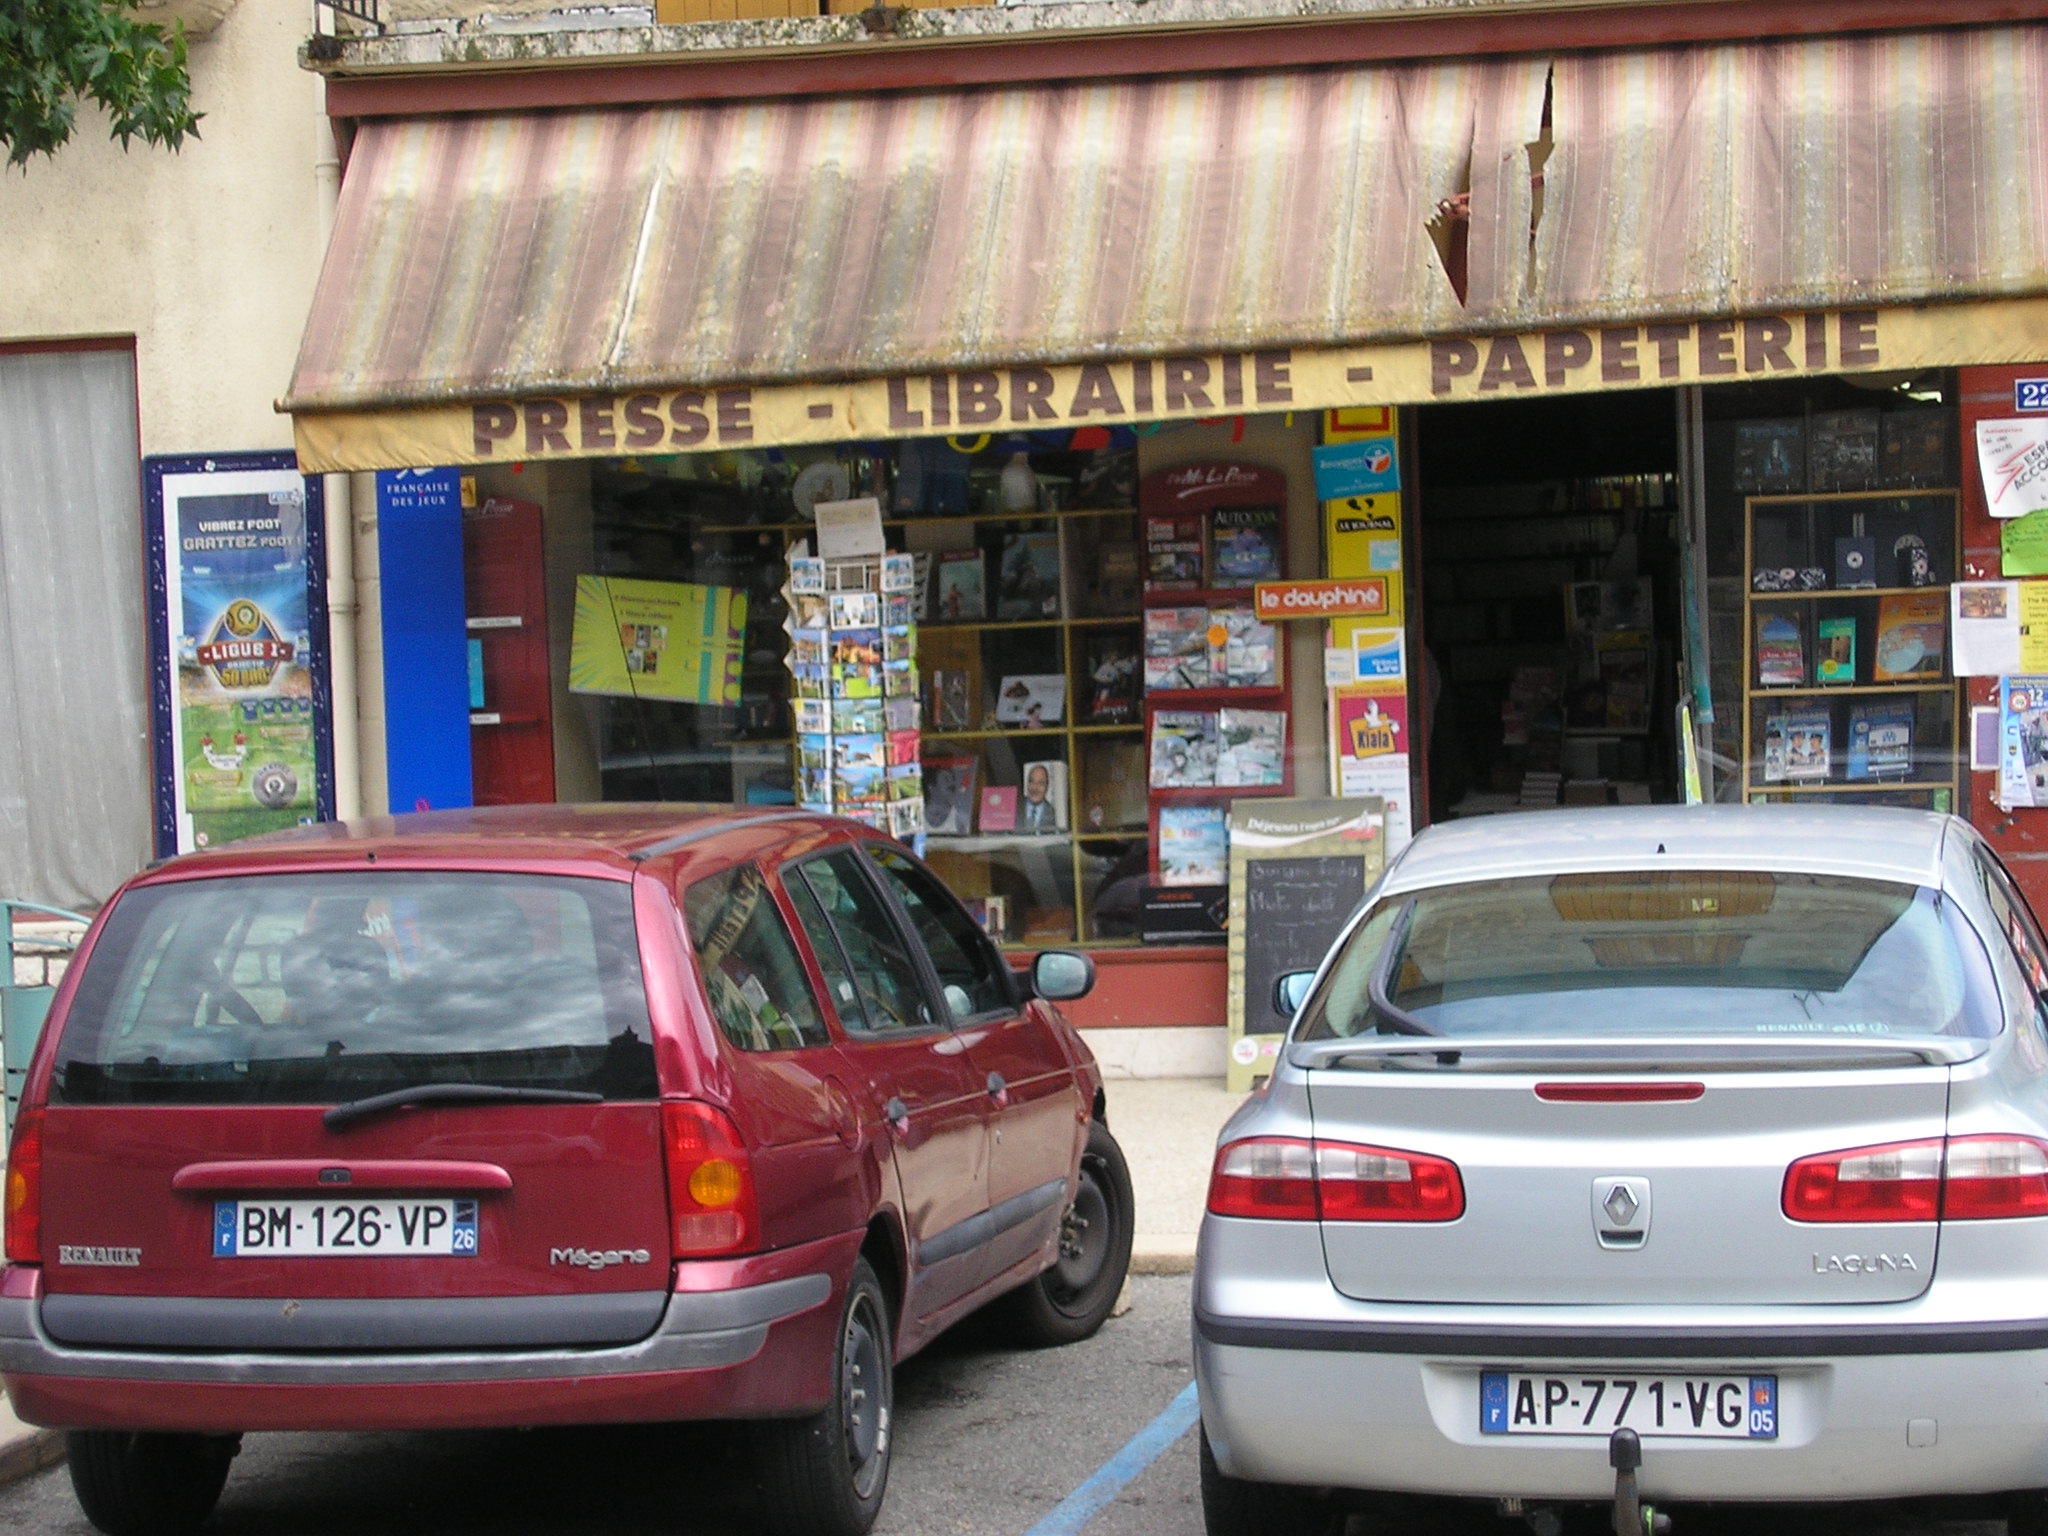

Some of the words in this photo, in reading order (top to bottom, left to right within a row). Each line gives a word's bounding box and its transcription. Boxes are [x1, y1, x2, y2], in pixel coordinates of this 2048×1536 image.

[473, 388, 754, 457] PRESSE
[887, 350, 1294, 430] LIBRAIRIE
[1430, 310, 1880, 396] PAPETERIE
[2023, 440, 2048, 466] ESP
[2014, 456, 2048, 491] ACCO
[386, 482, 450, 495] FRANÇAISE
[391, 497, 413, 507] DES
[418, 495, 446, 507] JEUX
[198, 519, 245, 532] VIBREZ
[247, 518, 282, 530] FOOT
[183, 536, 257, 551] GRATTEZ
[260, 536, 293, 547] FOOT
[1260, 589, 1280, 608] le
[211, 641, 264, 660] LIGUE
[1357, 729, 1390, 749] Kiala
[1755, 1022, 1824, 1033] RENAULT
[242, 1204, 447, 1248] BM-126-VP
[222, 1233, 231, 1247] F
[454, 1229, 475, 1250] 26
[59, 1245, 142, 1267] RENAULT
[549, 1247, 651, 1270] Mégane
[1812, 1252, 1918, 1276] LAGUNA
[1513, 1379, 1742, 1428] AP-771-VG
[1491, 1409, 1500, 1423] F
[1750, 1409, 1775, 1432] 05
